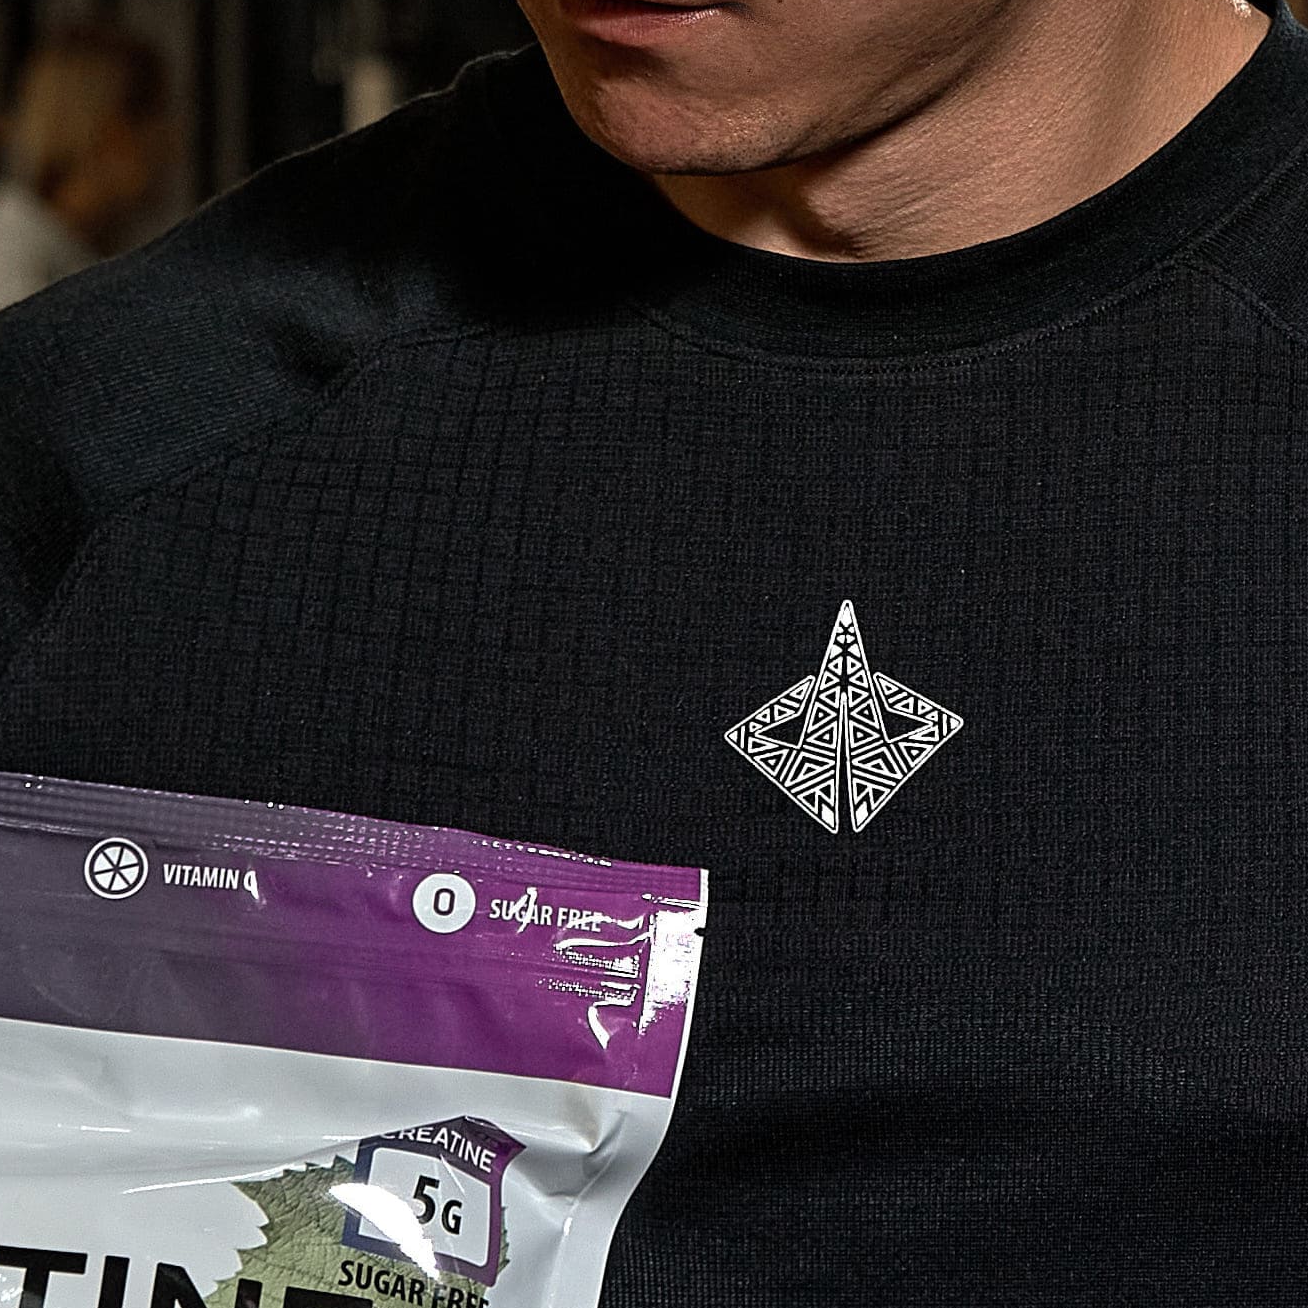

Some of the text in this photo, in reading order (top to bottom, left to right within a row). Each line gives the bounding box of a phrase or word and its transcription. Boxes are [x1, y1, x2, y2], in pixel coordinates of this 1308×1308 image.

[162, 863, 239, 890] VITAMIN
[489, 897, 602, 933] SUGAR FREE
[337, 1258, 426, 1308] SUGAR
